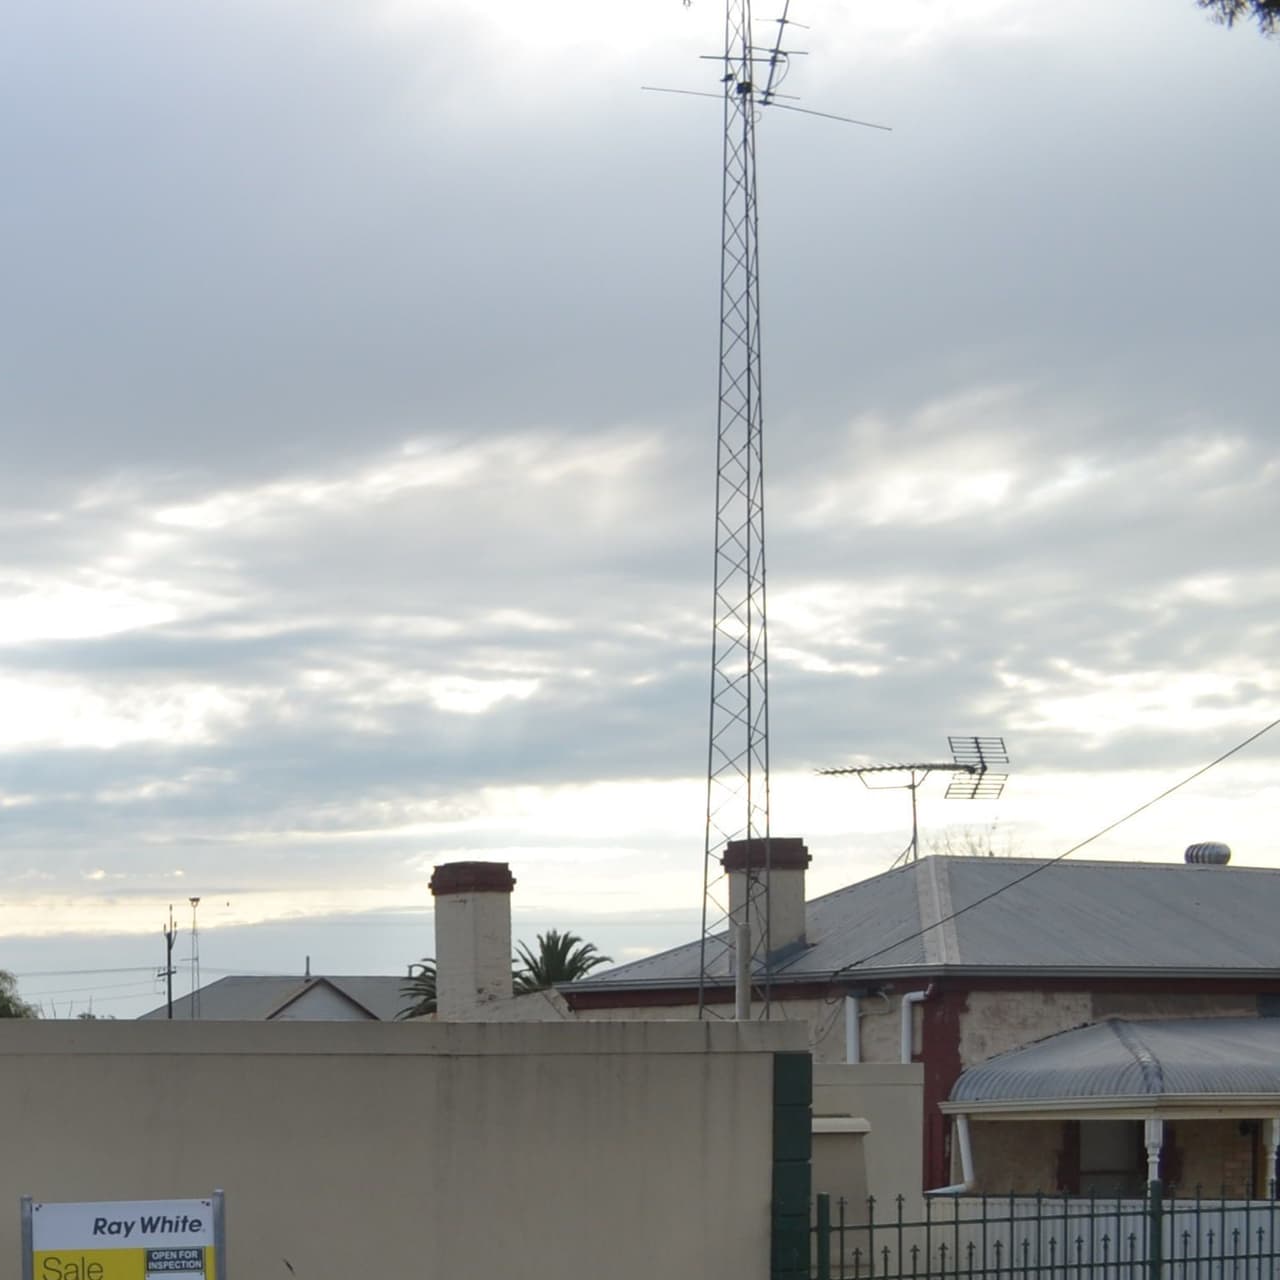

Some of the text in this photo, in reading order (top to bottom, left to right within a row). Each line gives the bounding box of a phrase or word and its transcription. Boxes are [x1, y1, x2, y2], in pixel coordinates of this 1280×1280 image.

[93, 1216, 203, 1238] Ray White
[152, 1250, 198, 1260] OPEN FOR
[148, 1260, 202, 1270] INSPECTION
